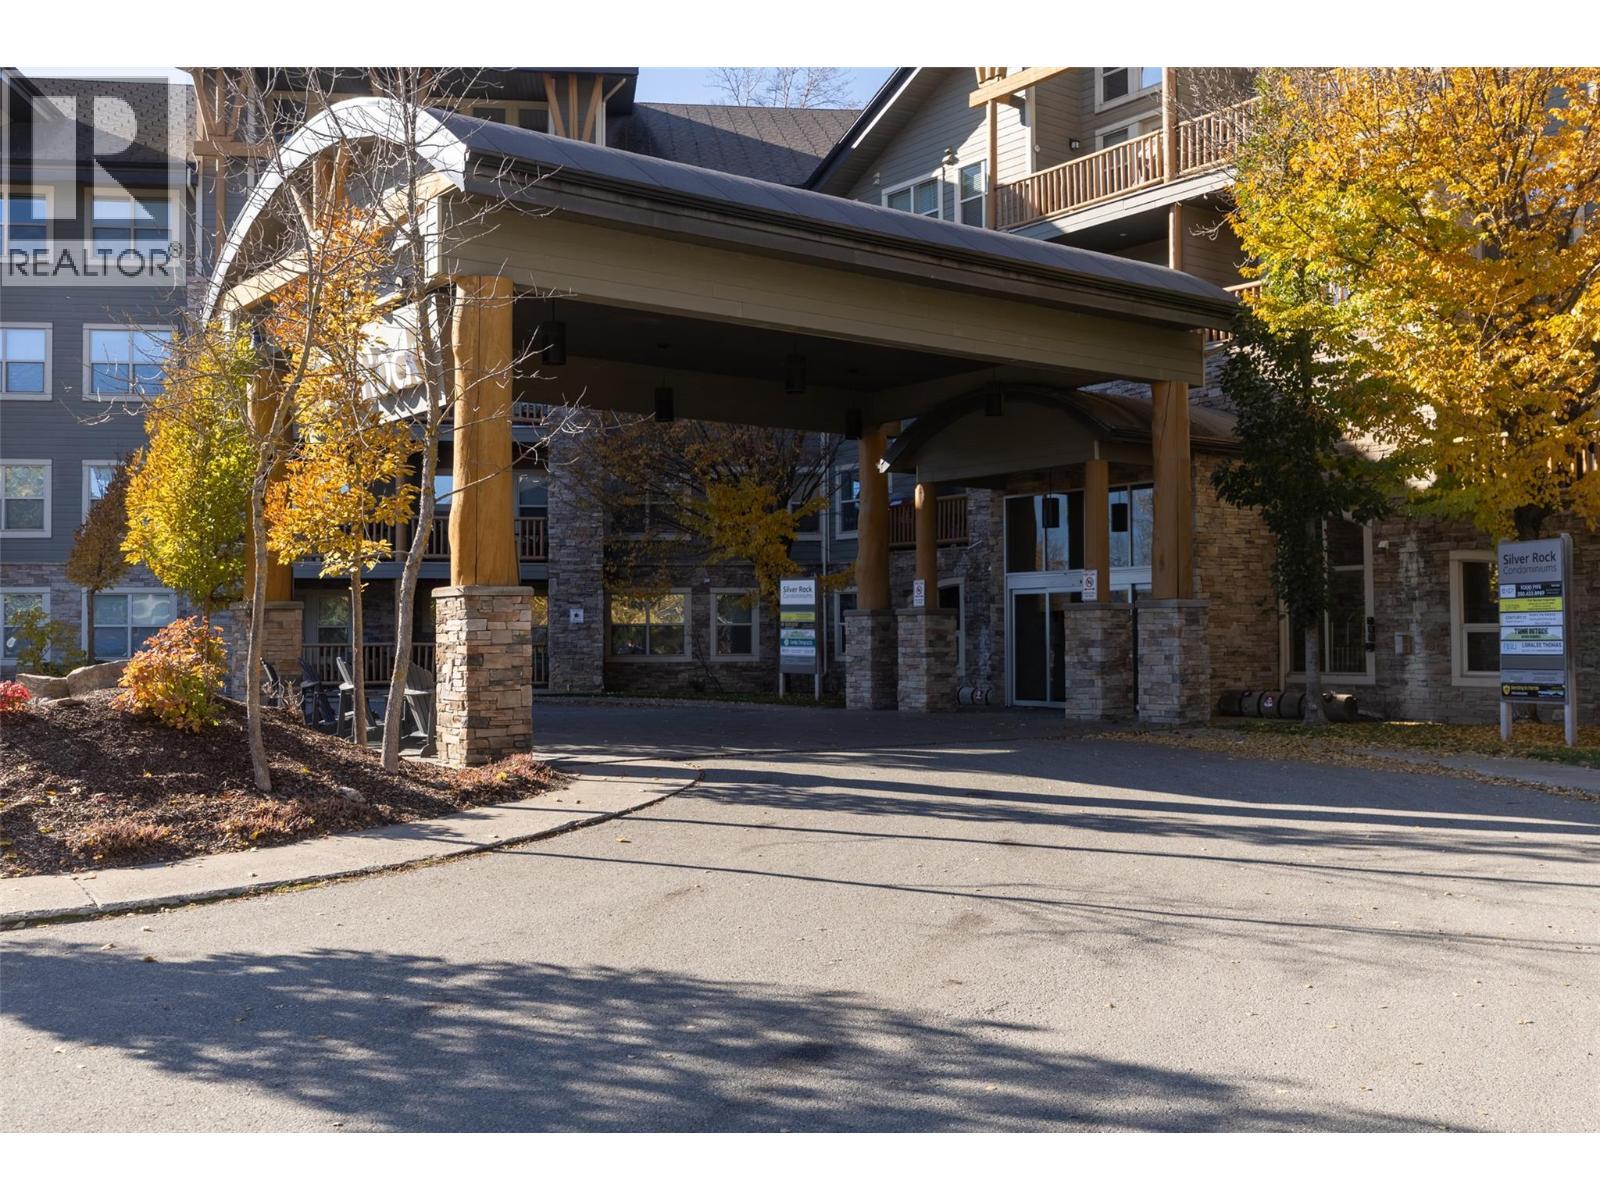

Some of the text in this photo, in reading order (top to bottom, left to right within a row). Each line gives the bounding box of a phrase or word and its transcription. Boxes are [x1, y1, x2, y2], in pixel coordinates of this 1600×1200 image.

[1503, 550, 1557, 565] Silver Rock
[1502, 564, 1558, 575] Condominiums
[782, 585, 813, 593] Silver Rock
